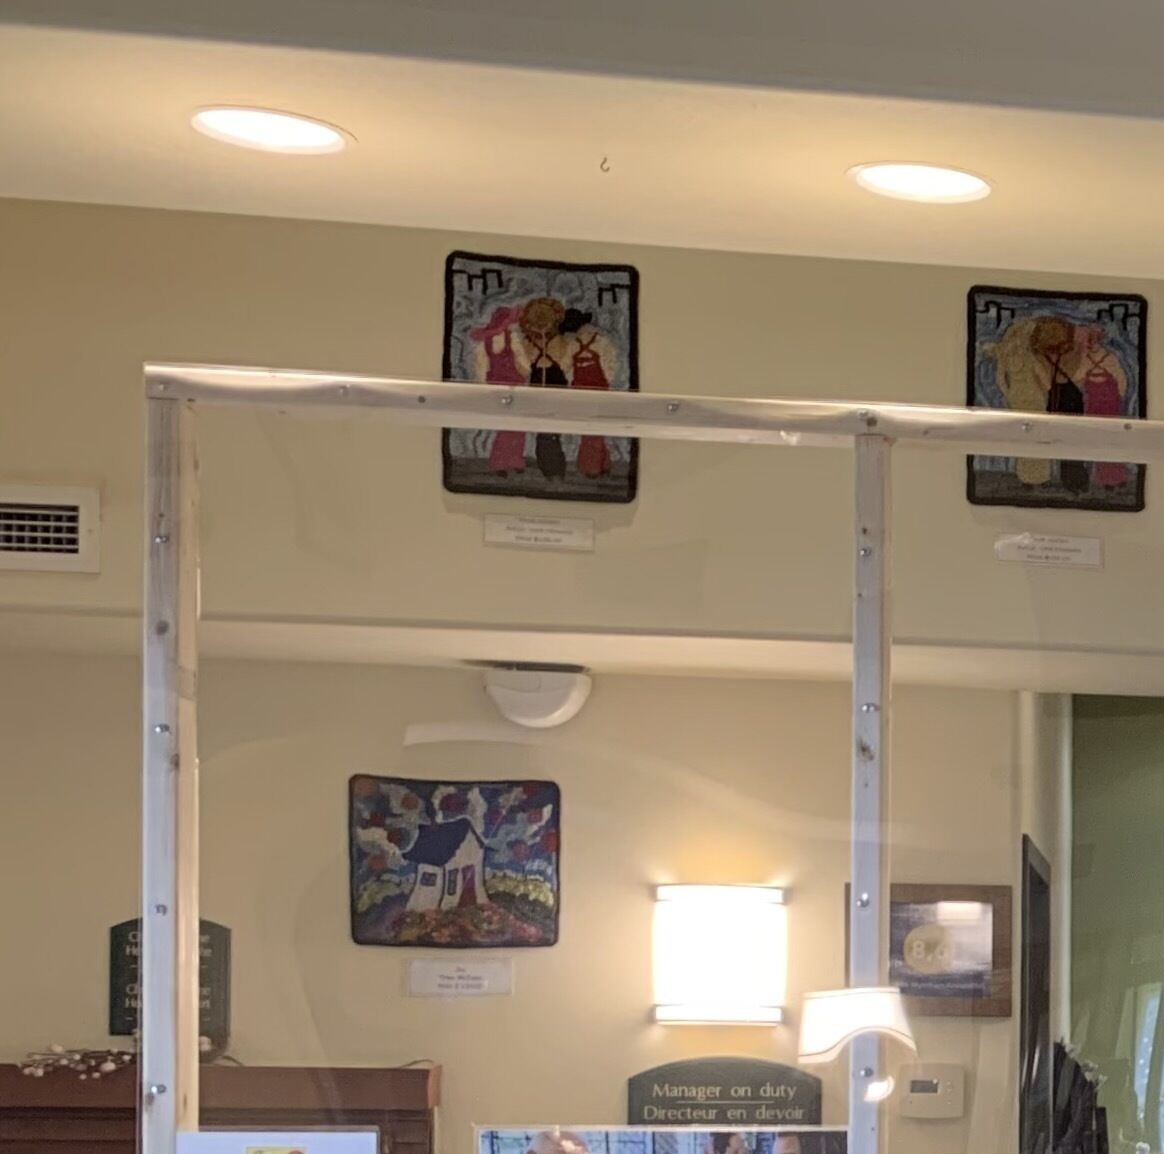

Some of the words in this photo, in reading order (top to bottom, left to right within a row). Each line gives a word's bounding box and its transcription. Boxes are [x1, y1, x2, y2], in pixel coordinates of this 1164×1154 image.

[652, 1083, 722, 1101] Manager
[730, 1086, 751, 1098] on
[759, 1082, 797, 1099] duty
[643, 1105, 719, 1121] Directeur
[727, 1108, 747, 1120] en
[756, 1104, 805, 1120] devoir
